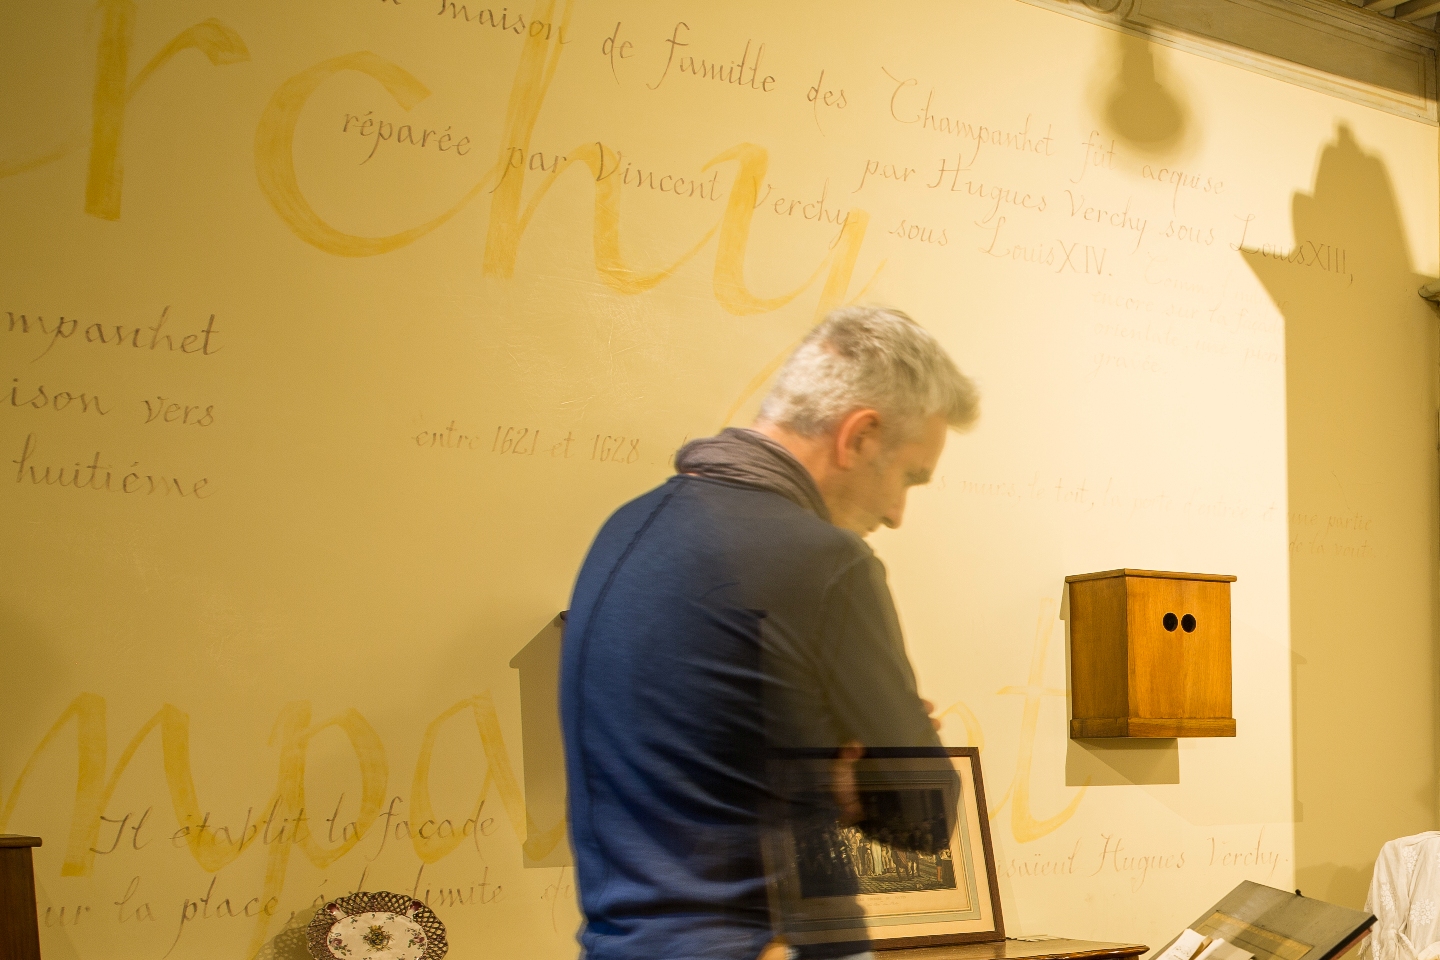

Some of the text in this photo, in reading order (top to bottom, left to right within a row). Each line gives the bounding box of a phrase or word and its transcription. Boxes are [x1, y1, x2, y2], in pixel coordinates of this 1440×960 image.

[438, 0, 573, 45] maison
[601, 21, 635, 89] de
[646, 21, 775, 92] famille
[806, 69, 848, 137] des
[1142, 163, 1226, 218] acquise
[342, 109, 472, 166] réparée
[489, 146, 568, 194] par
[595, 141, 726, 204] Vincent
[752, 175, 860, 251] Verchy
[888, 218, 949, 247] sous
[851, 157, 917, 195] par
[926, 152, 1048, 225] Hugues
[1064, 189, 1149, 256] Verchy
[1159, 218, 1216, 246] sous
[8, 377, 215, 428] ison vers
[411, 420, 482, 451] entre
[491, 425, 540, 456] 1621
[549, 431, 576, 460] et
[89, 806, 153, 855] Il
[326, 791, 364, 844] la
[1088, 832, 1187, 893] Hugues
[38, 904, 91, 930] ur
[114, 874, 157, 925] la
